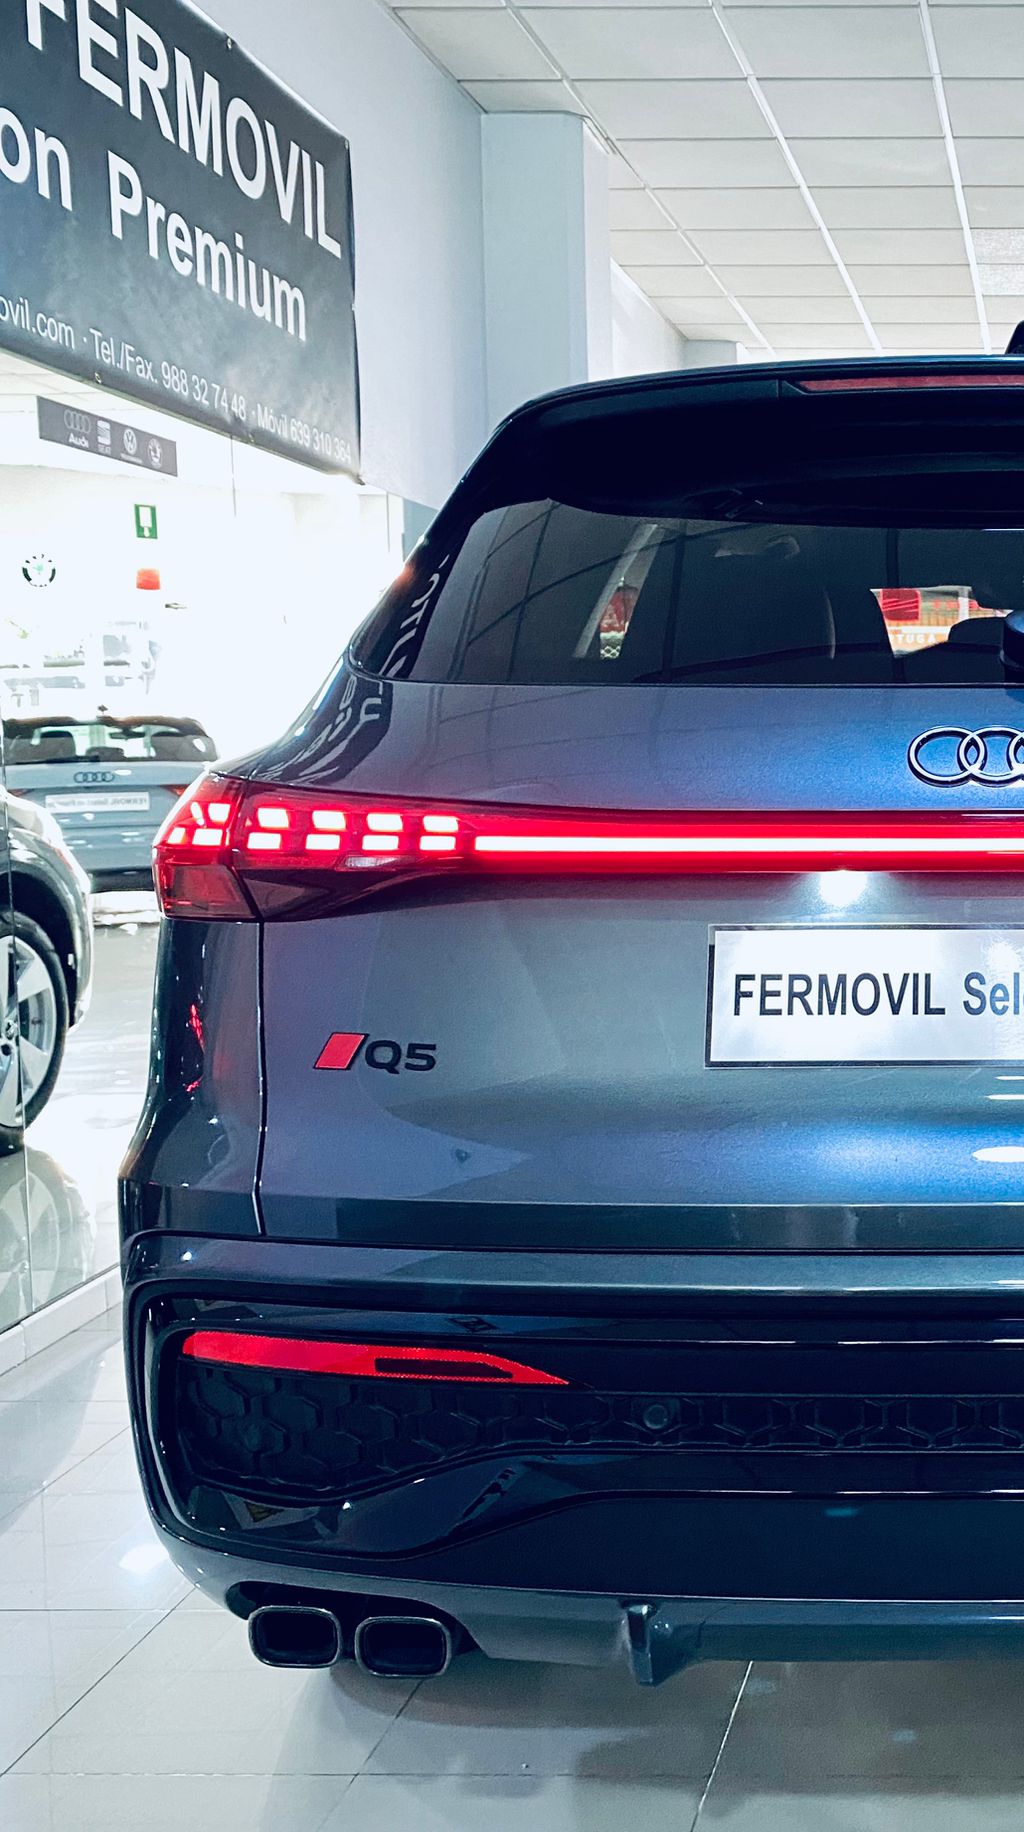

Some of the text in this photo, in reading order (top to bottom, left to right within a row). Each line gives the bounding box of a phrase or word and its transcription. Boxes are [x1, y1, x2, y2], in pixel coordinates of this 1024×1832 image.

[0, 107, 306, 341] on Premium
[161, 361, 188, 396] 988
[191, 374, 209, 406] 32
[211, 383, 229, 413] 74
[230, 391, 246, 420] 48
[290, 418, 310, 448] 639
[312, 428, 332, 456] 310
[733, 972, 945, 1017] FERMOVIL
[365, 1040, 437, 1074] Q5
